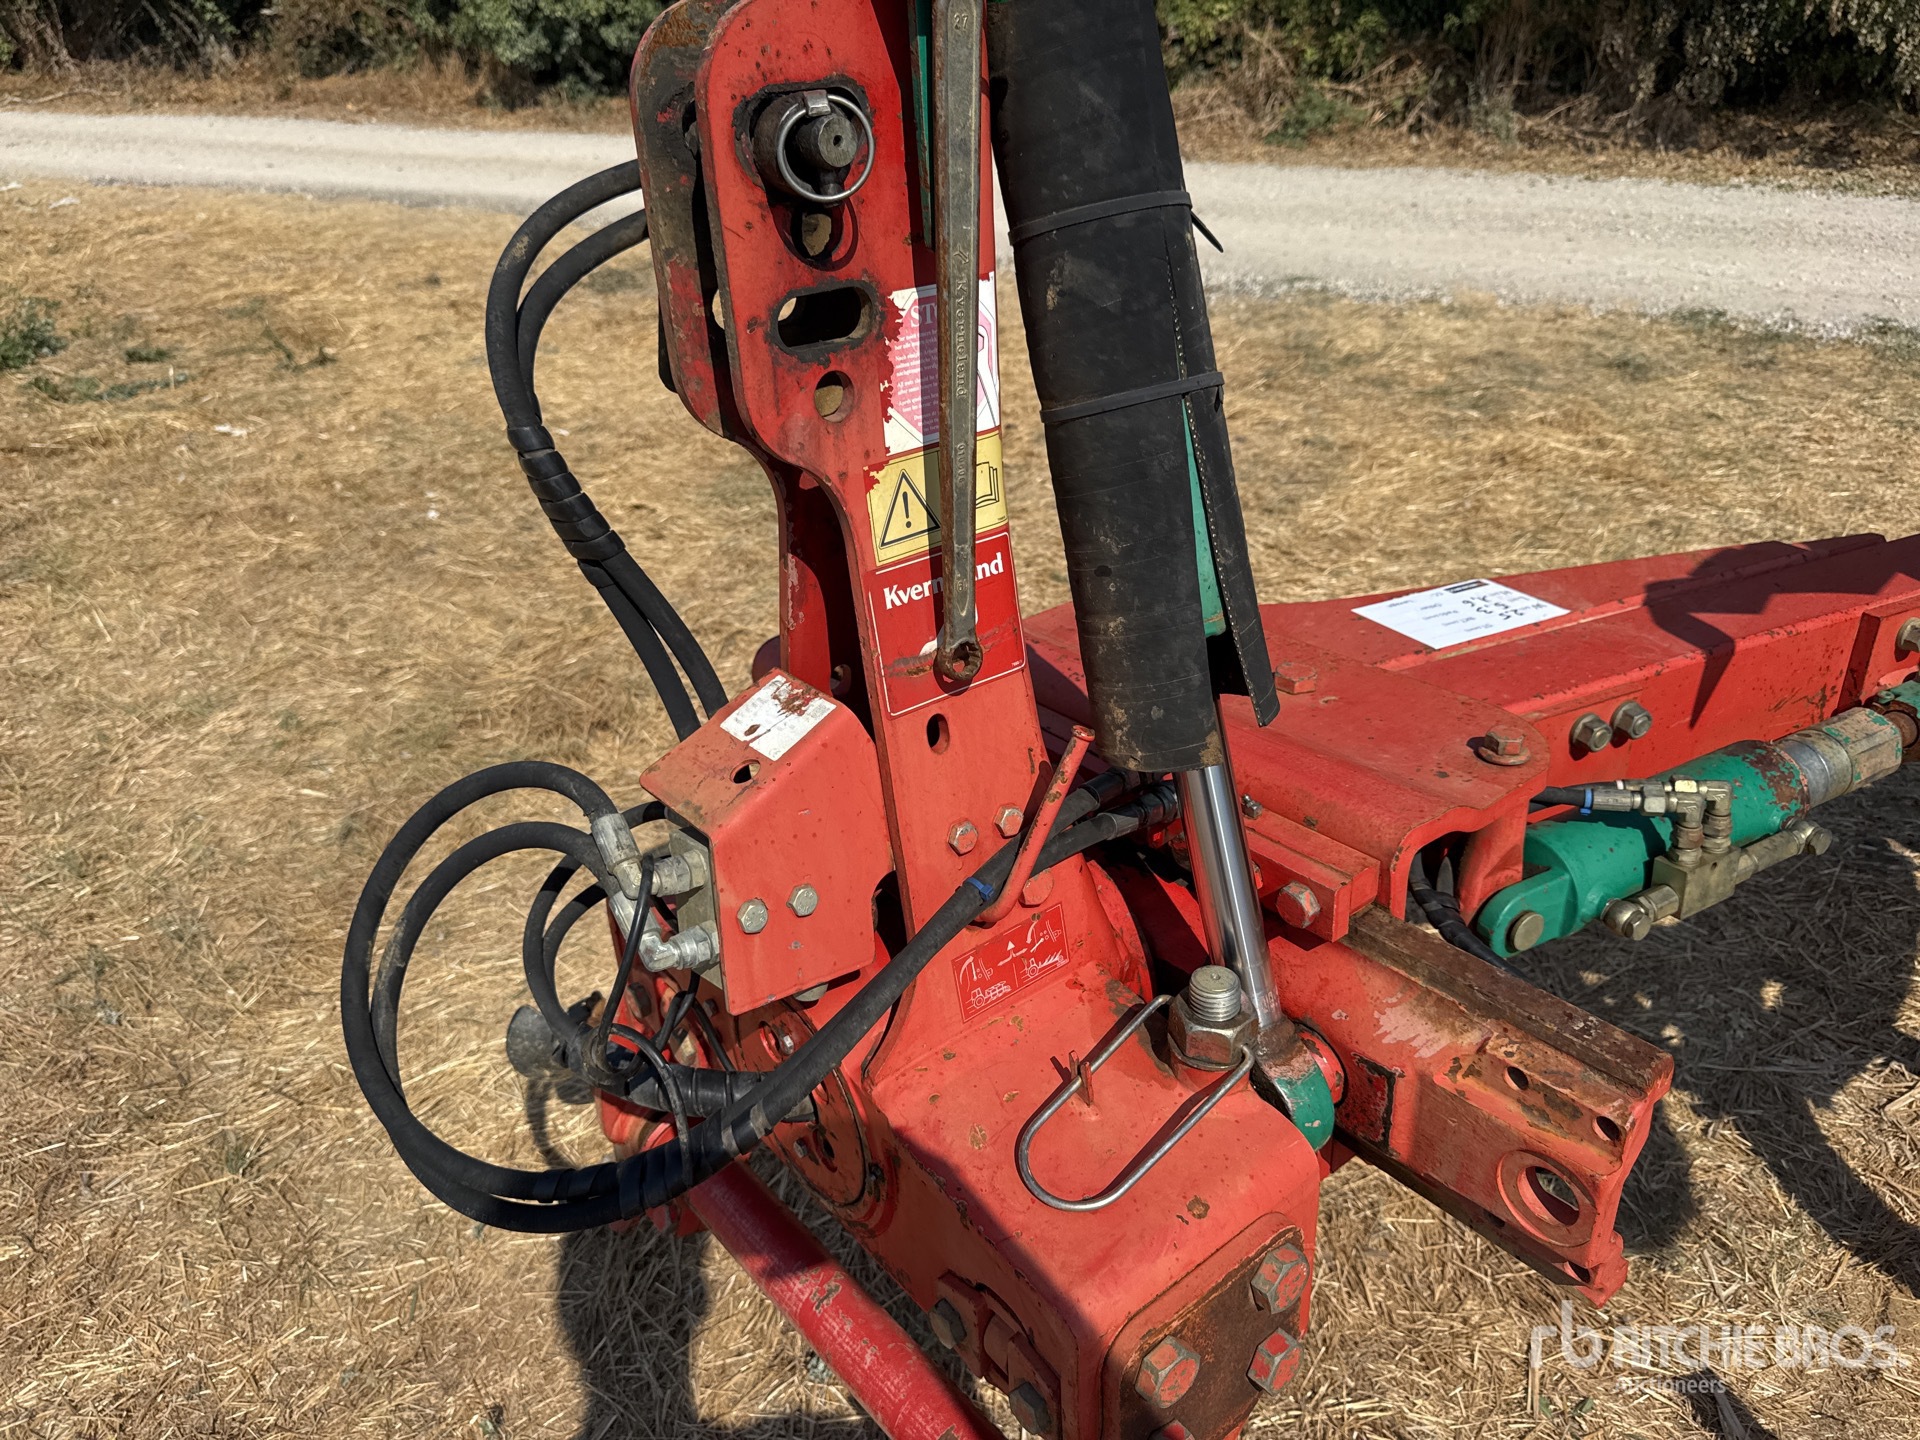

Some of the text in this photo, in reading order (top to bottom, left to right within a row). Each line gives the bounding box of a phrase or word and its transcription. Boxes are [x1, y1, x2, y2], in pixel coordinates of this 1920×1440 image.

[953, 13, 969, 30] 27
[910, 302, 937, 328] ST
[955, 279, 968, 399] Kverneland
[883, 551, 1004, 611] Kvernnd
